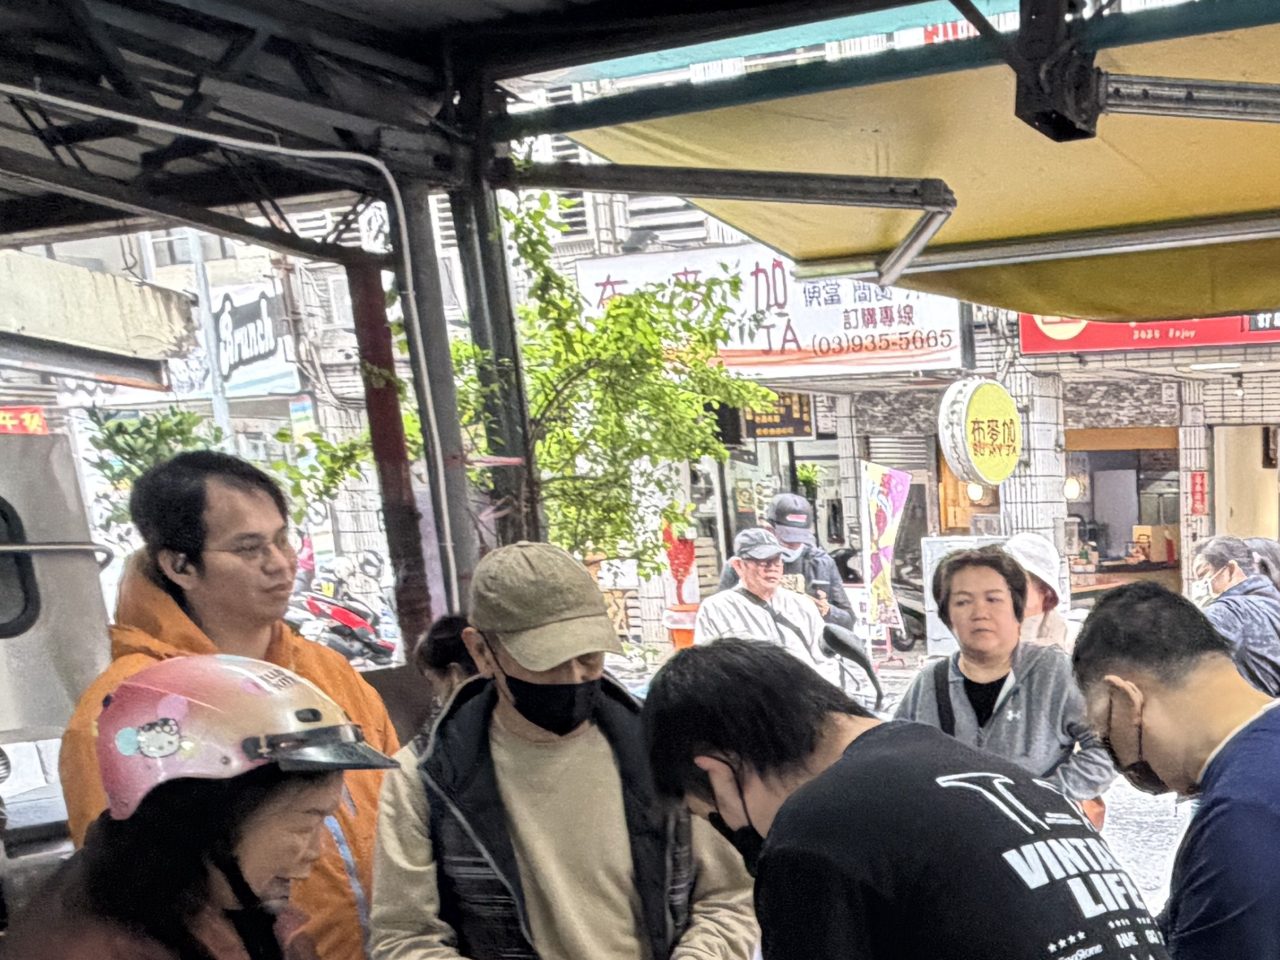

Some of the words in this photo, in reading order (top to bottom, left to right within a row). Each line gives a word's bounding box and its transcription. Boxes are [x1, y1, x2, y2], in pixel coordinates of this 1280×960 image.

[219, 298, 276, 376] Brunch
[843, 304, 915, 330] 訂購專線
[1002, 838, 1122, 890] VINTA
[1066, 872, 1148, 919] LIFE
